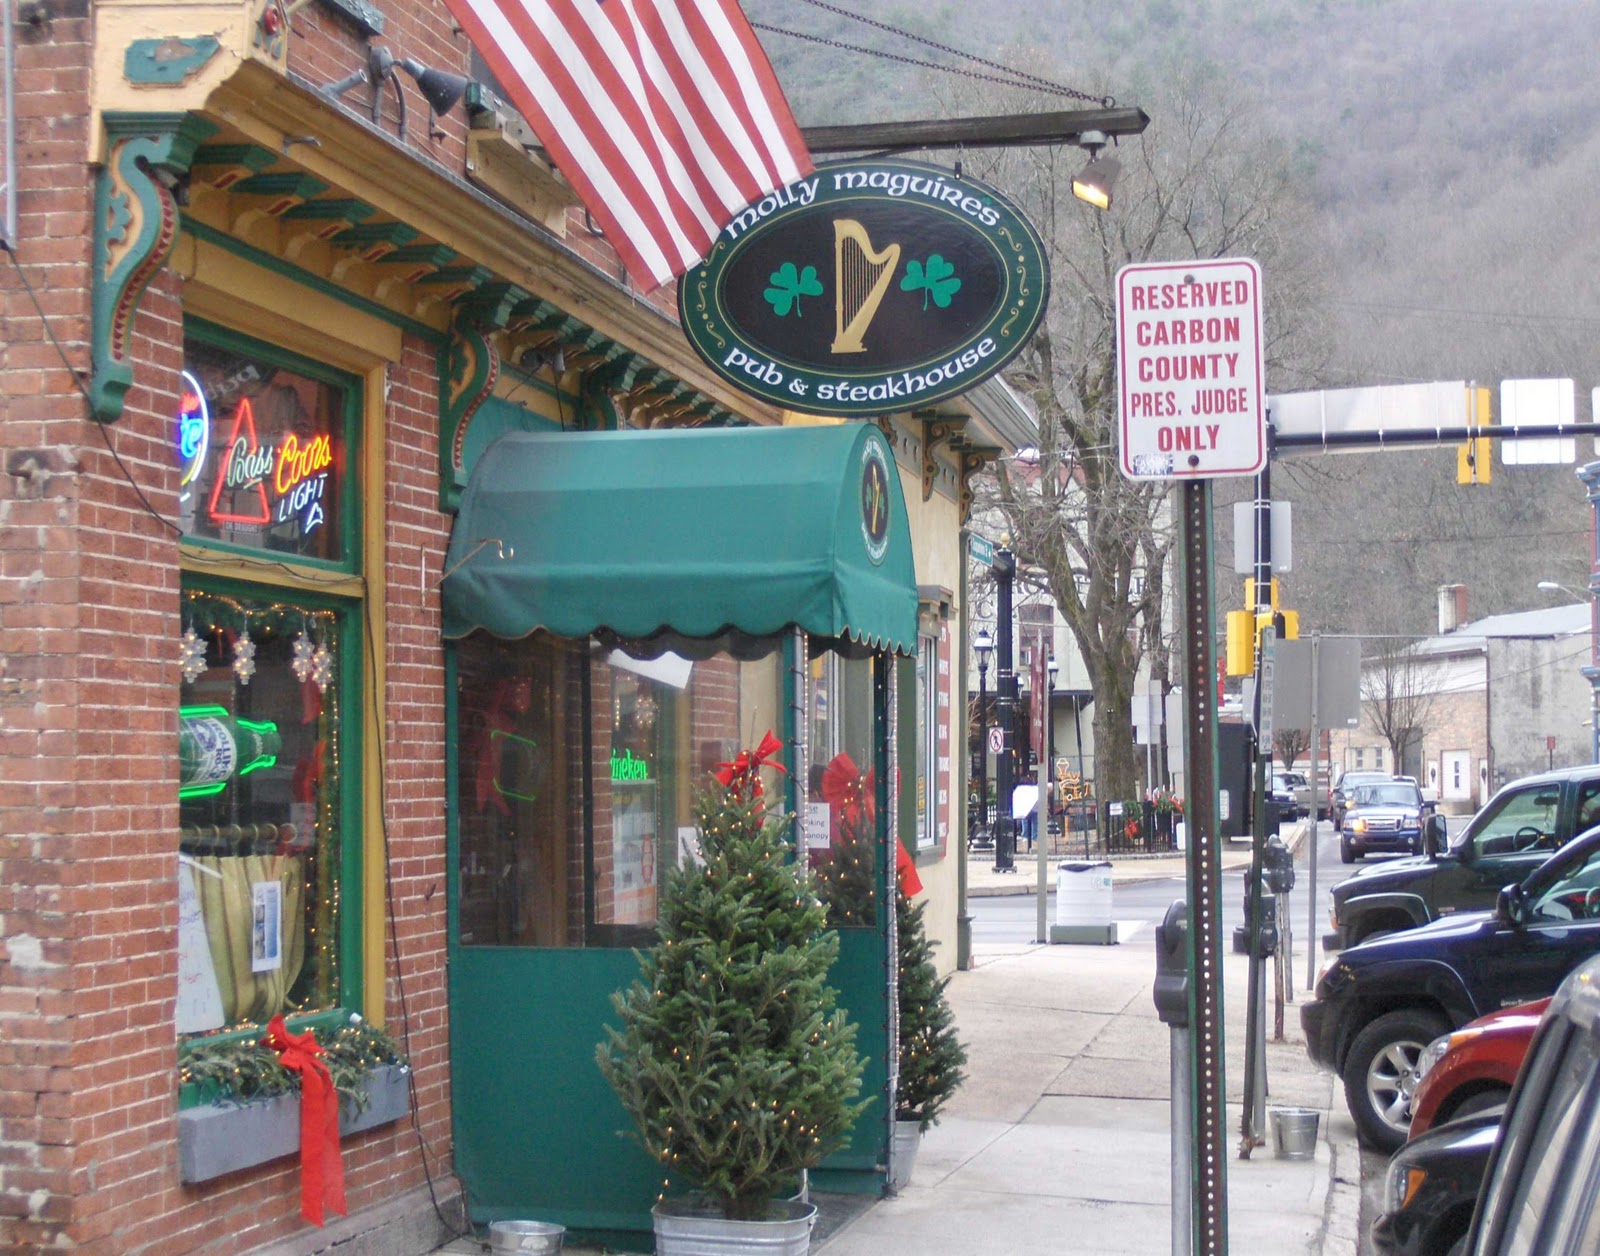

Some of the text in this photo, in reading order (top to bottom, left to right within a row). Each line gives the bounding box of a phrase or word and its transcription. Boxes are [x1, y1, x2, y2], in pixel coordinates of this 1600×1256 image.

[724, 170, 1002, 240] molly maguires
[1131, 280, 1248, 311] RESERVED
[1136, 317, 1240, 347] CARBON
[724, 337, 997, 402] pub & steakhouse
[1138, 352, 1239, 383] COUNTY
[1131, 388, 1248, 418] PRES. JUDGE
[1158, 424, 1220, 452] ONLY
[227, 436, 273, 488] Bass
[276, 434, 332, 493] Coors
[278, 473, 328, 522] LIGHT
[610, 748, 648, 780] ineken
